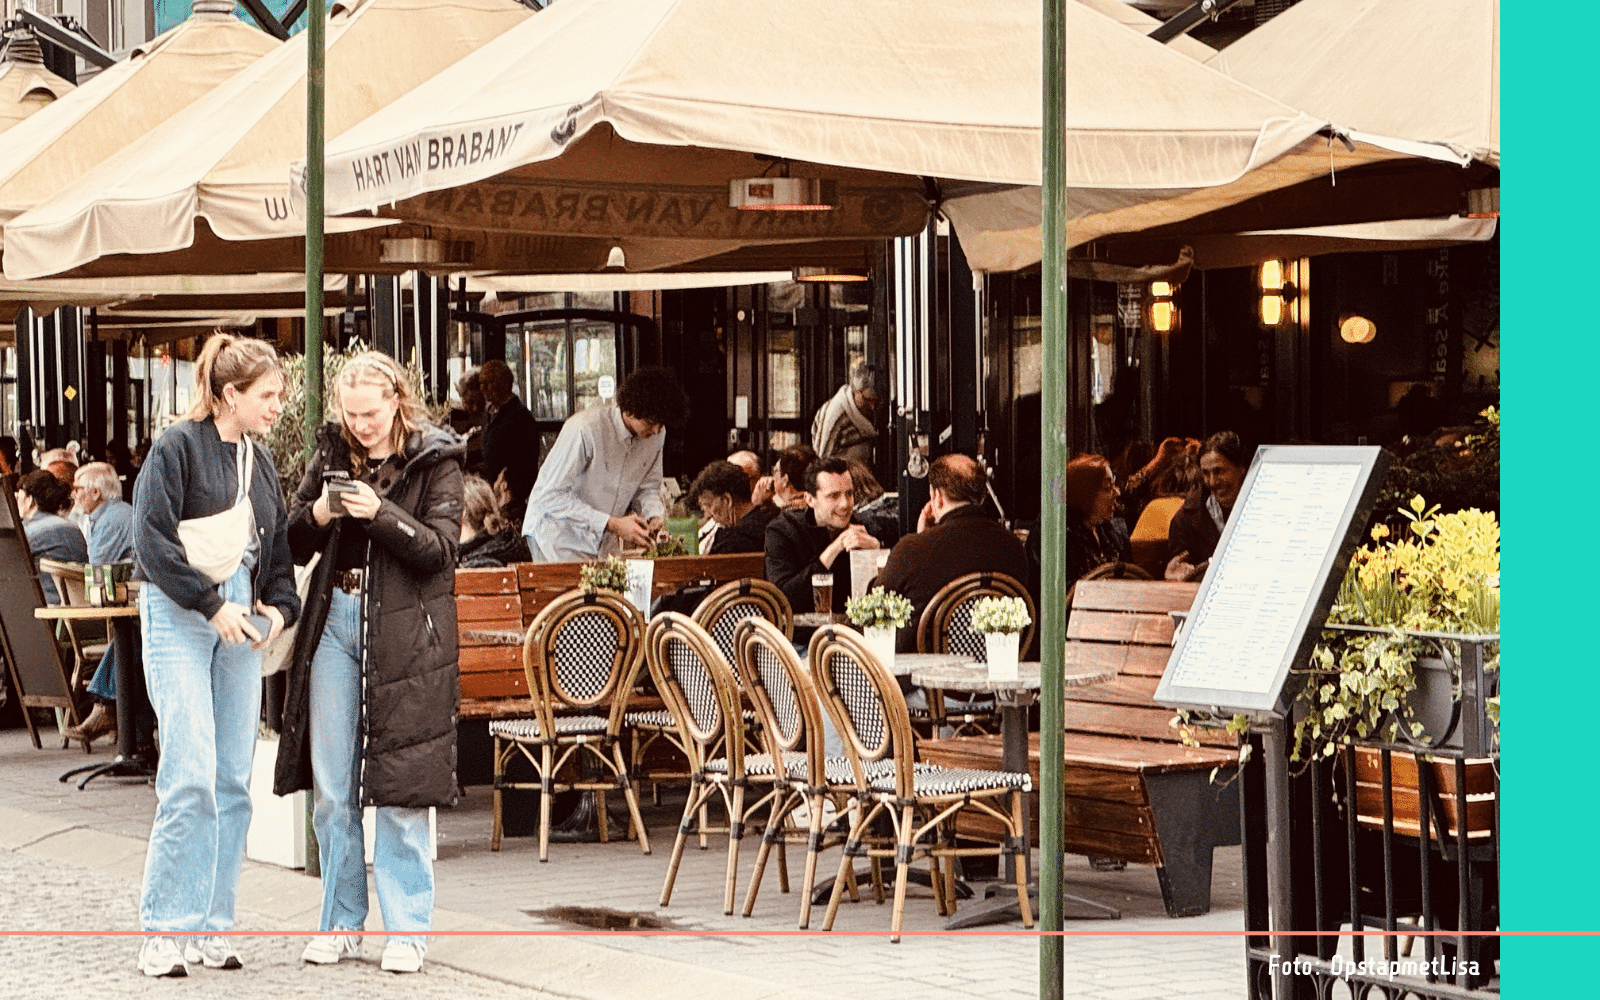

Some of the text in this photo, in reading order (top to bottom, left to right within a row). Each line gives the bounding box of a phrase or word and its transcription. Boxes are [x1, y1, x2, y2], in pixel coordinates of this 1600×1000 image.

[352, 122, 524, 192] HART VAN BRABANT
